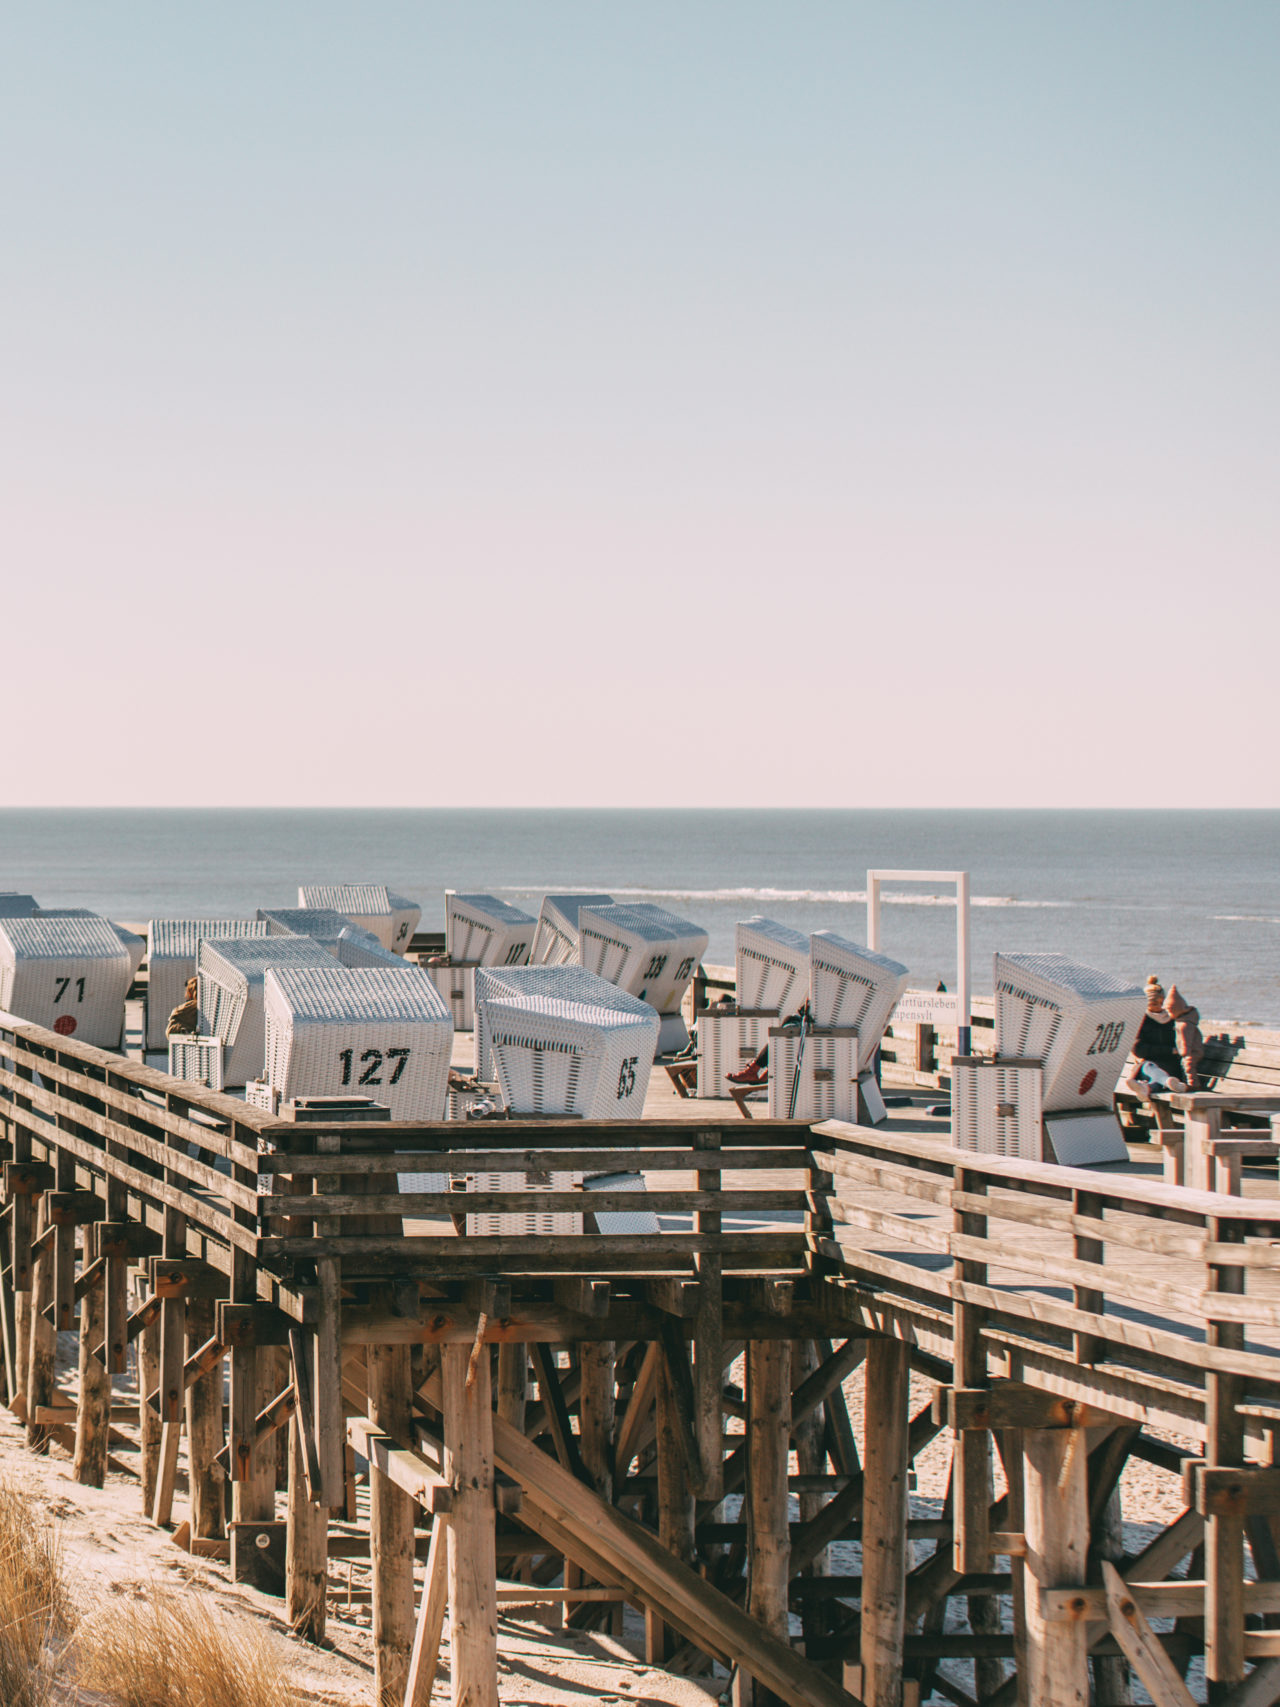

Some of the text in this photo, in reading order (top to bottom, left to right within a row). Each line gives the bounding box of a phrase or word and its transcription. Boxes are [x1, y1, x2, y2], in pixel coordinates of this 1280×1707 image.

[505, 943, 526, 964] 117
[54, 977, 86, 1003] 71
[1086, 1021, 1125, 1055] 208
[339, 1048, 411, 1085] 127
[616, 1056, 639, 1099] 65
